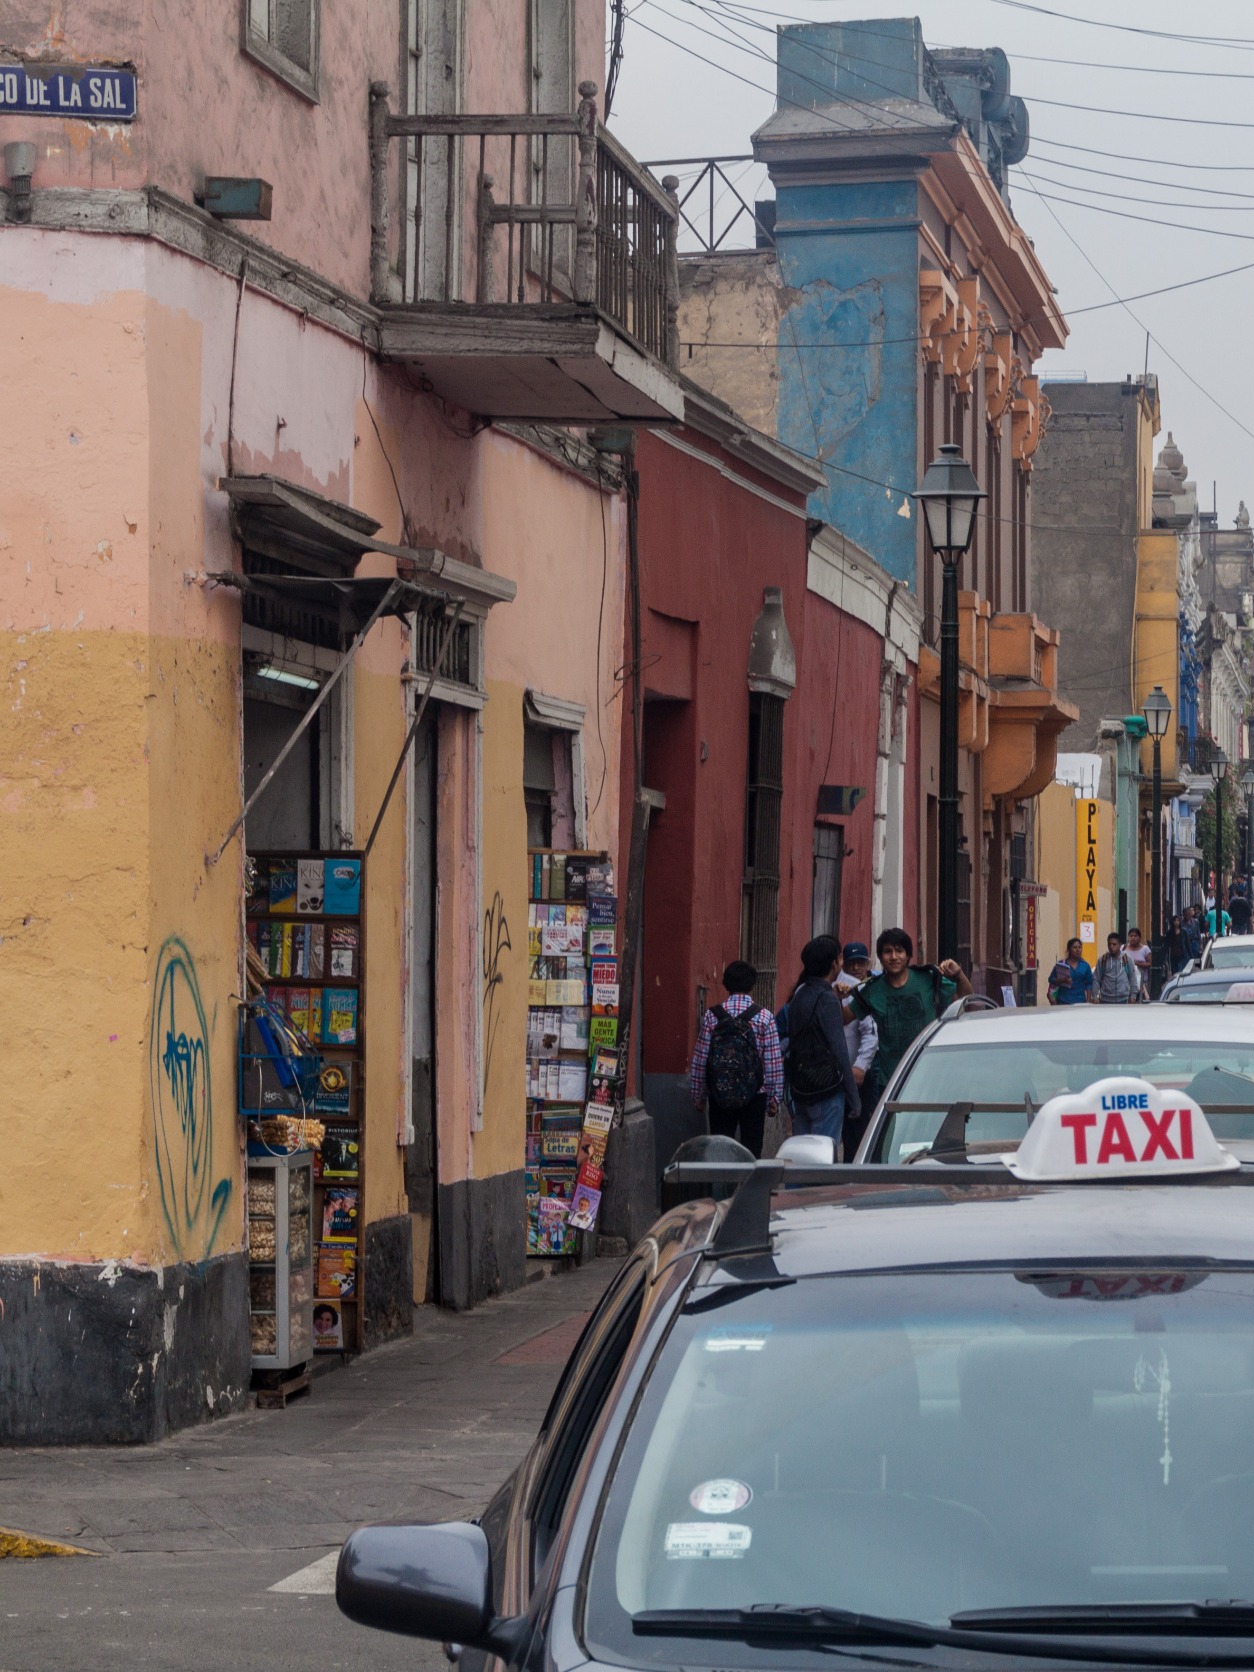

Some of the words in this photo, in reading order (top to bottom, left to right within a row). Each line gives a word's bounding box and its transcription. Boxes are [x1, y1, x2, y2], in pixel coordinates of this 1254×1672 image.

[25, 75, 51, 106] DE
[58, 75, 82, 107] LA
[89, 77, 127, 109] SAL
[1085, 802, 1097, 911] PLAYA
[1020, 884, 1048, 895] ELEFONO
[1028, 905, 1037, 959] OFICINA
[593, 969, 616, 980] MIEDO
[1101, 1093, 1149, 1110] LIBRE
[547, 1144, 576, 1154] Letras
[1060, 1109, 1195, 1165] TAXI
